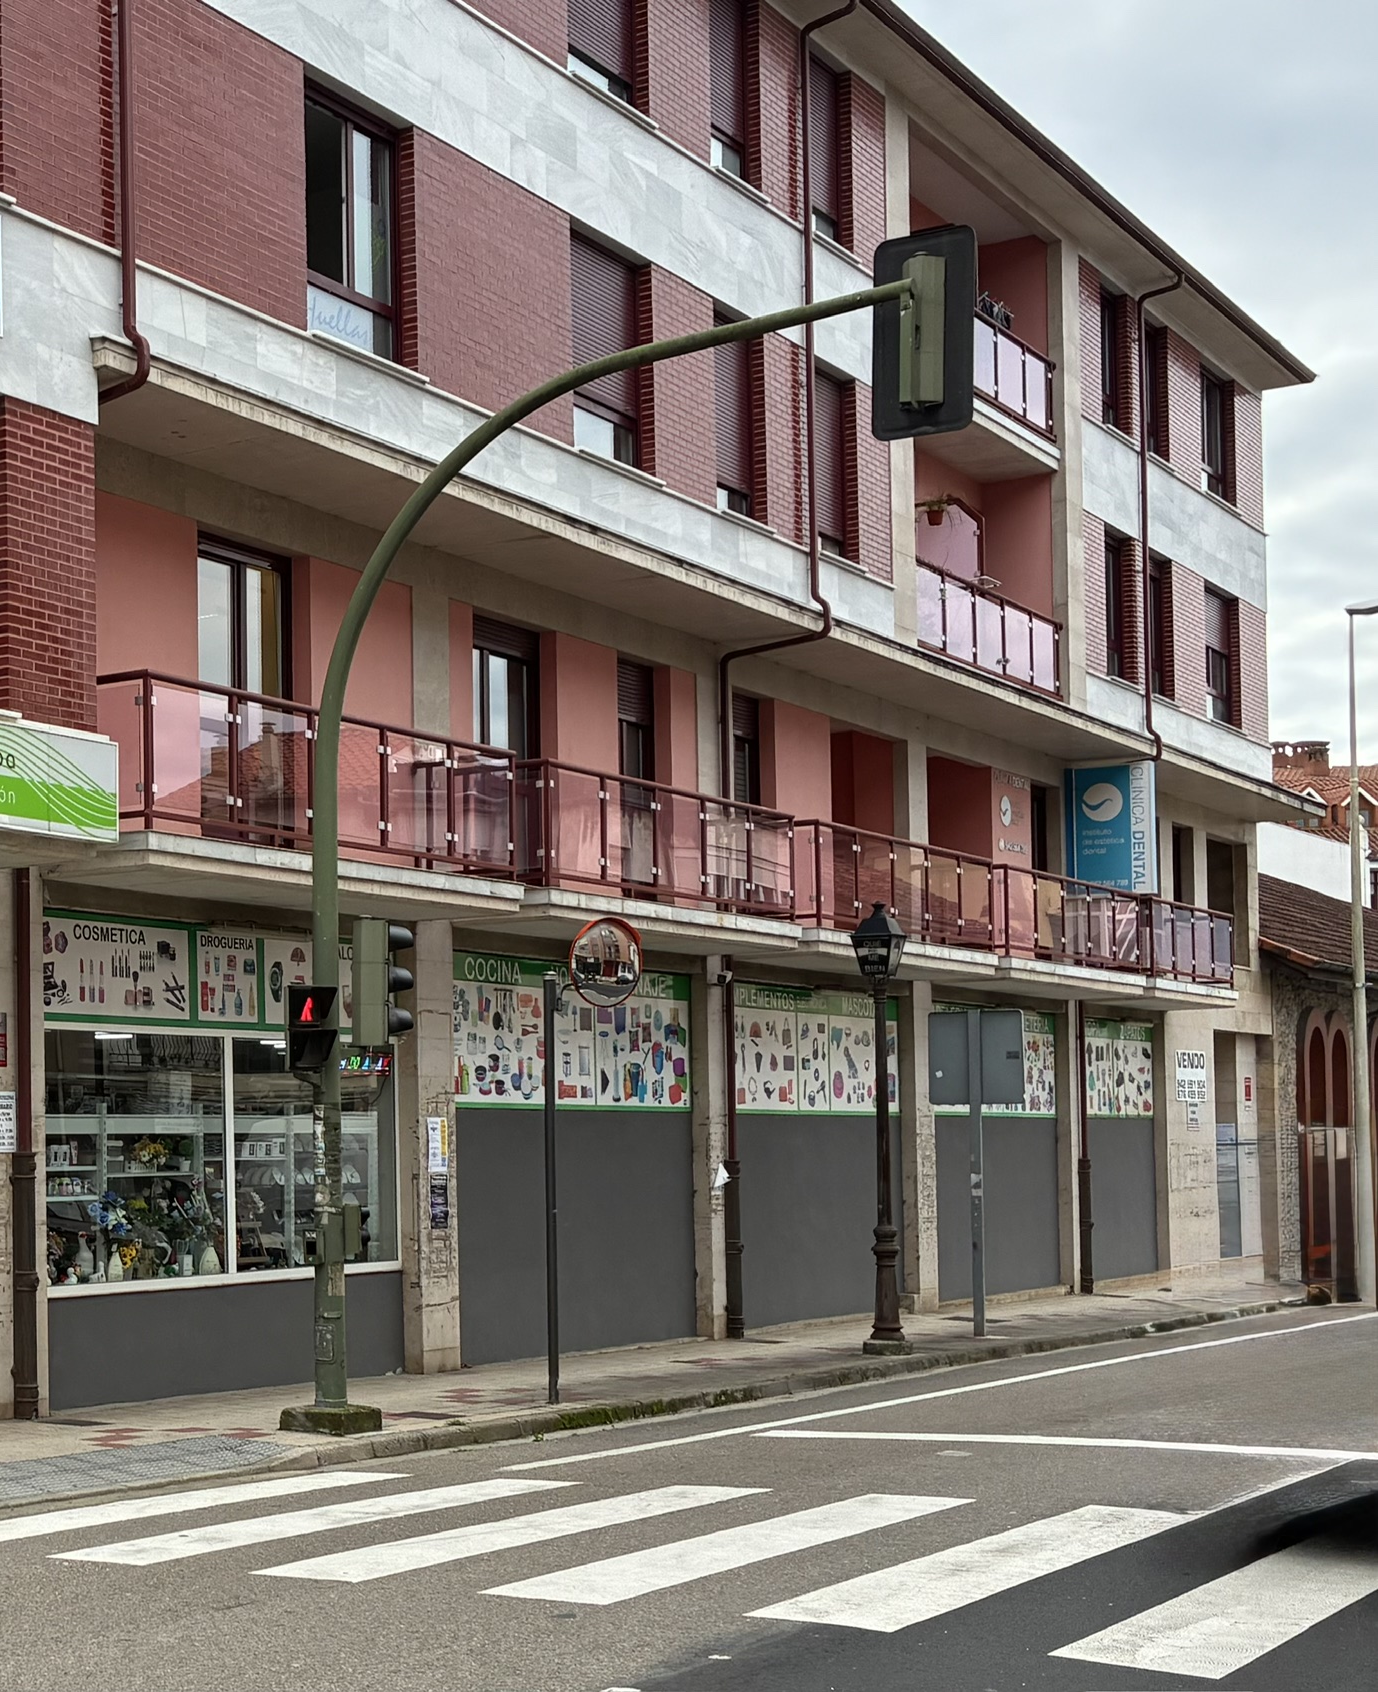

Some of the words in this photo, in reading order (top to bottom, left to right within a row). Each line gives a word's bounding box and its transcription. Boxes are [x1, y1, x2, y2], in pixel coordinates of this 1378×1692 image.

[1132, 830, 1146, 890] DENTAL
[73, 924, 146, 946] COSMETICA
[200, 934, 254, 951] DROGUERIA
[464, 957, 522, 984] COCINA
[636, 975, 667, 998] NAJE
[734, 987, 795, 1010] MPLEMENTOS
[841, 997, 874, 1016] MASCOT
[1024, 1015, 1050, 1033] ETERIA
[1176, 1051, 1205, 1070] VENDO
